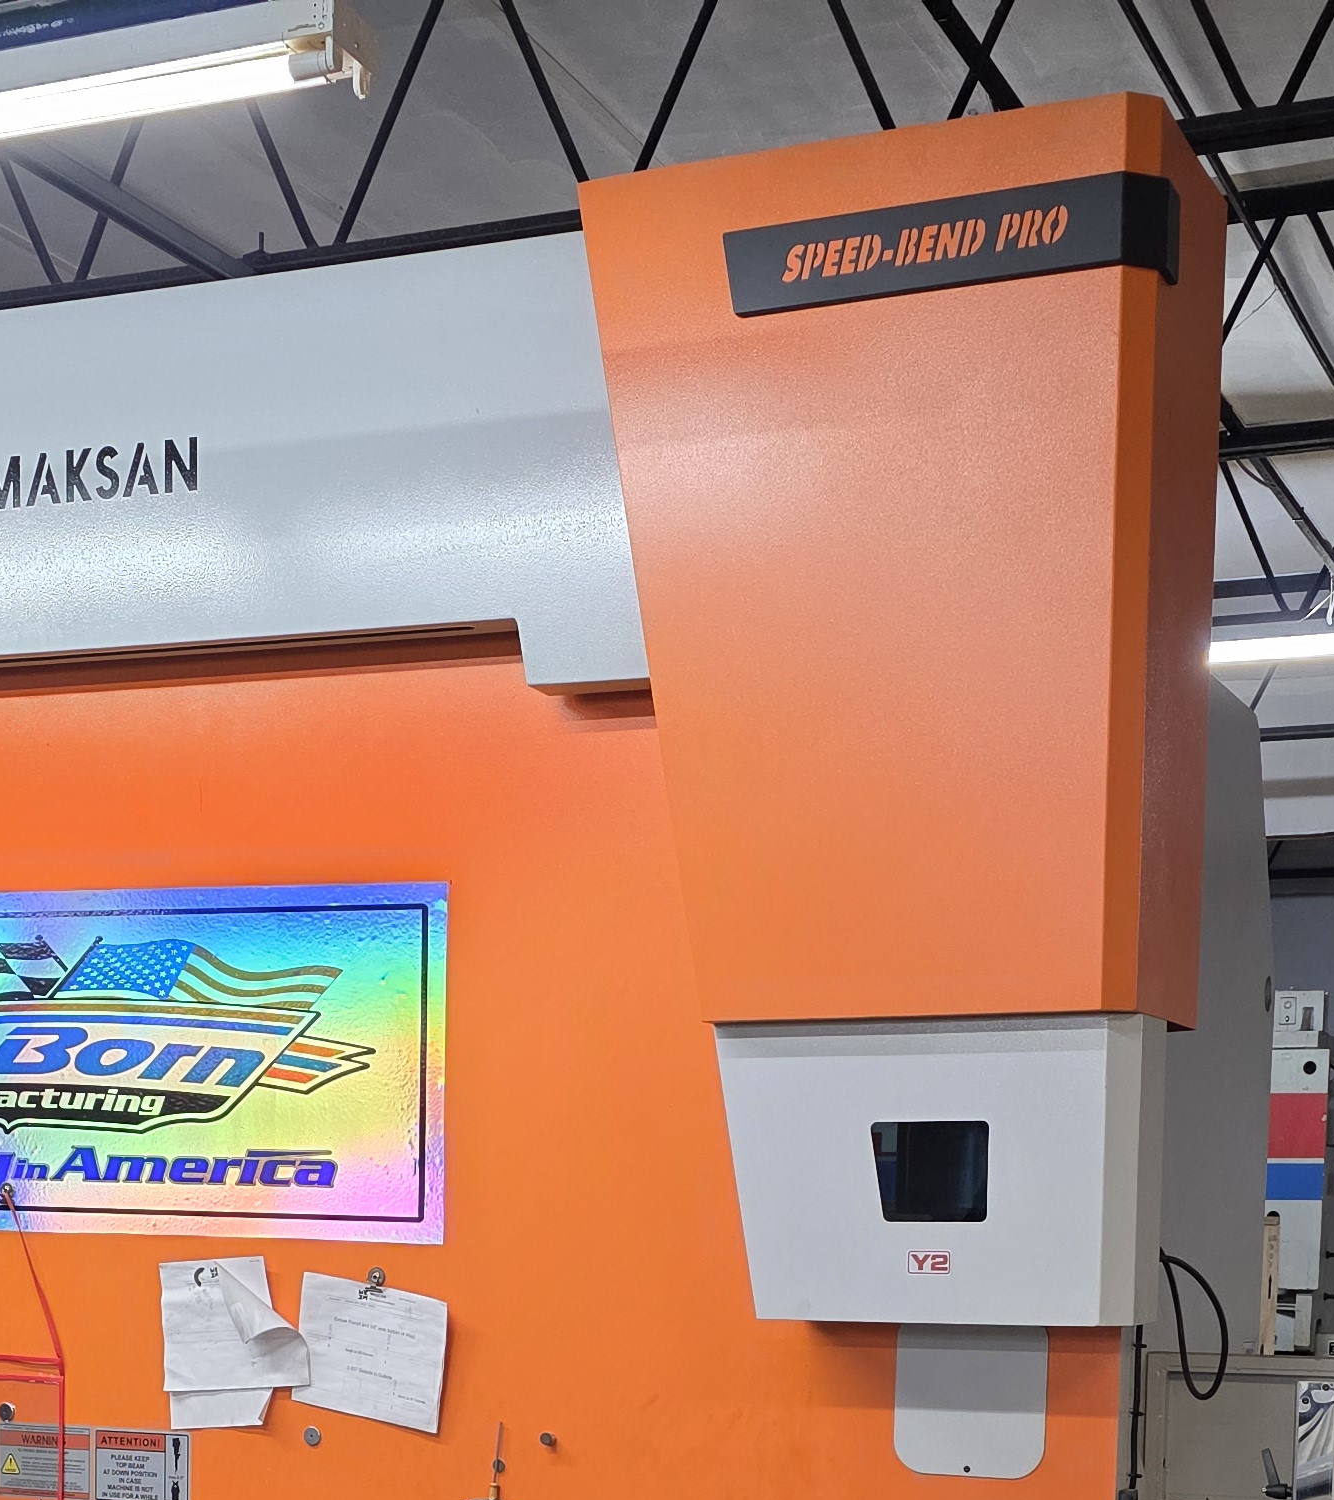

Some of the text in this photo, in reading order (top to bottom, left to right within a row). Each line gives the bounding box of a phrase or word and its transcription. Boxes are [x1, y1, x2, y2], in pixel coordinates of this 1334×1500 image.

[781, 204, 1069, 284] SPEED-BEND PRO
[14, 1158, 51, 1181] in
[51, 1144, 339, 1190] America
[910, 1253, 949, 1271] Y2
[101, 1436, 160, 1448] ATTENTION!
[111, 1454, 133, 1462] PLEASE
[131, 1470, 158, 1478] POSITION
